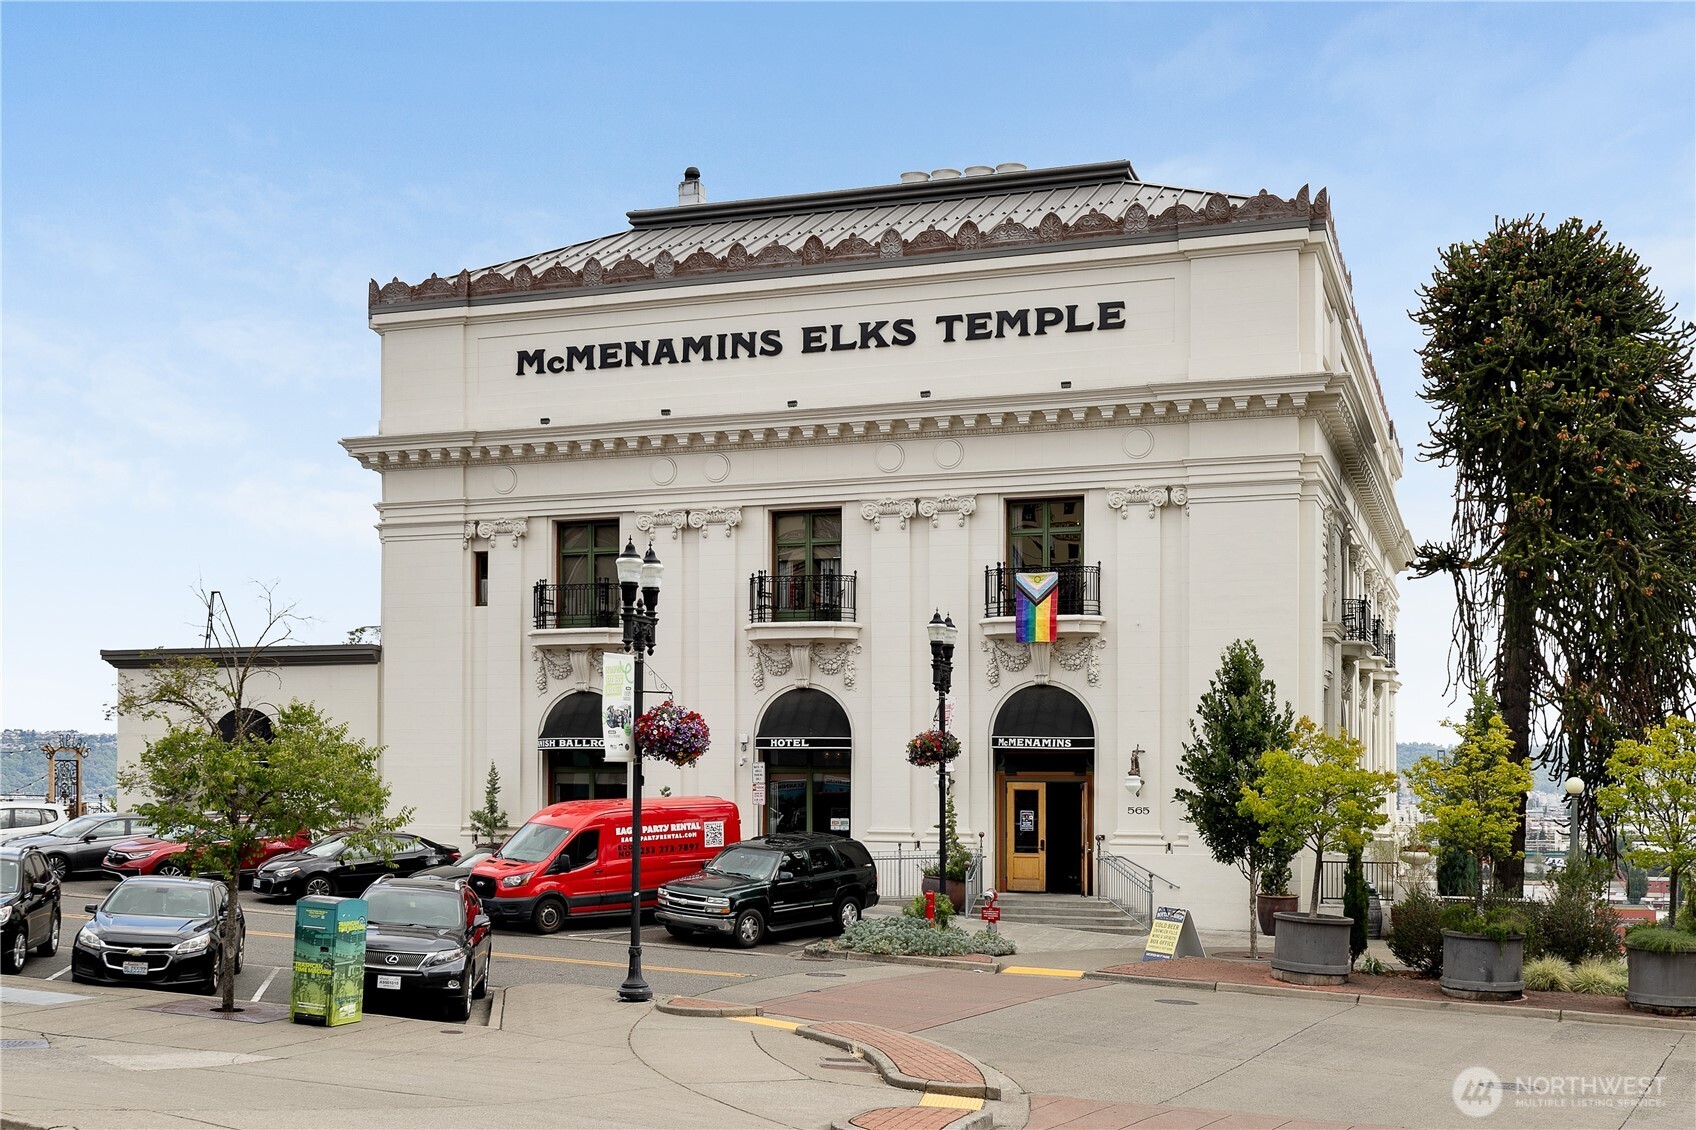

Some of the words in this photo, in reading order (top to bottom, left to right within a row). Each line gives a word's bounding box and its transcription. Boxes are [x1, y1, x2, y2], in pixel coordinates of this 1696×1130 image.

[516, 329, 783, 376] McMENAMINS
[801, 318, 916, 354] ELKS
[936, 301, 1126, 342] TEMPLE
[559, 739, 605, 747] BALLRO
[770, 738, 809, 747] HOTEL
[998, 738, 1072, 748] McMENAMINS
[1127, 806, 1150, 815] 565
[642, 824, 669, 834] PARTY
[670, 822, 701, 832] RENTAL
[621, 832, 697, 843] EAGPARTYRENTAL.COM
[619, 850, 633, 858] NO
